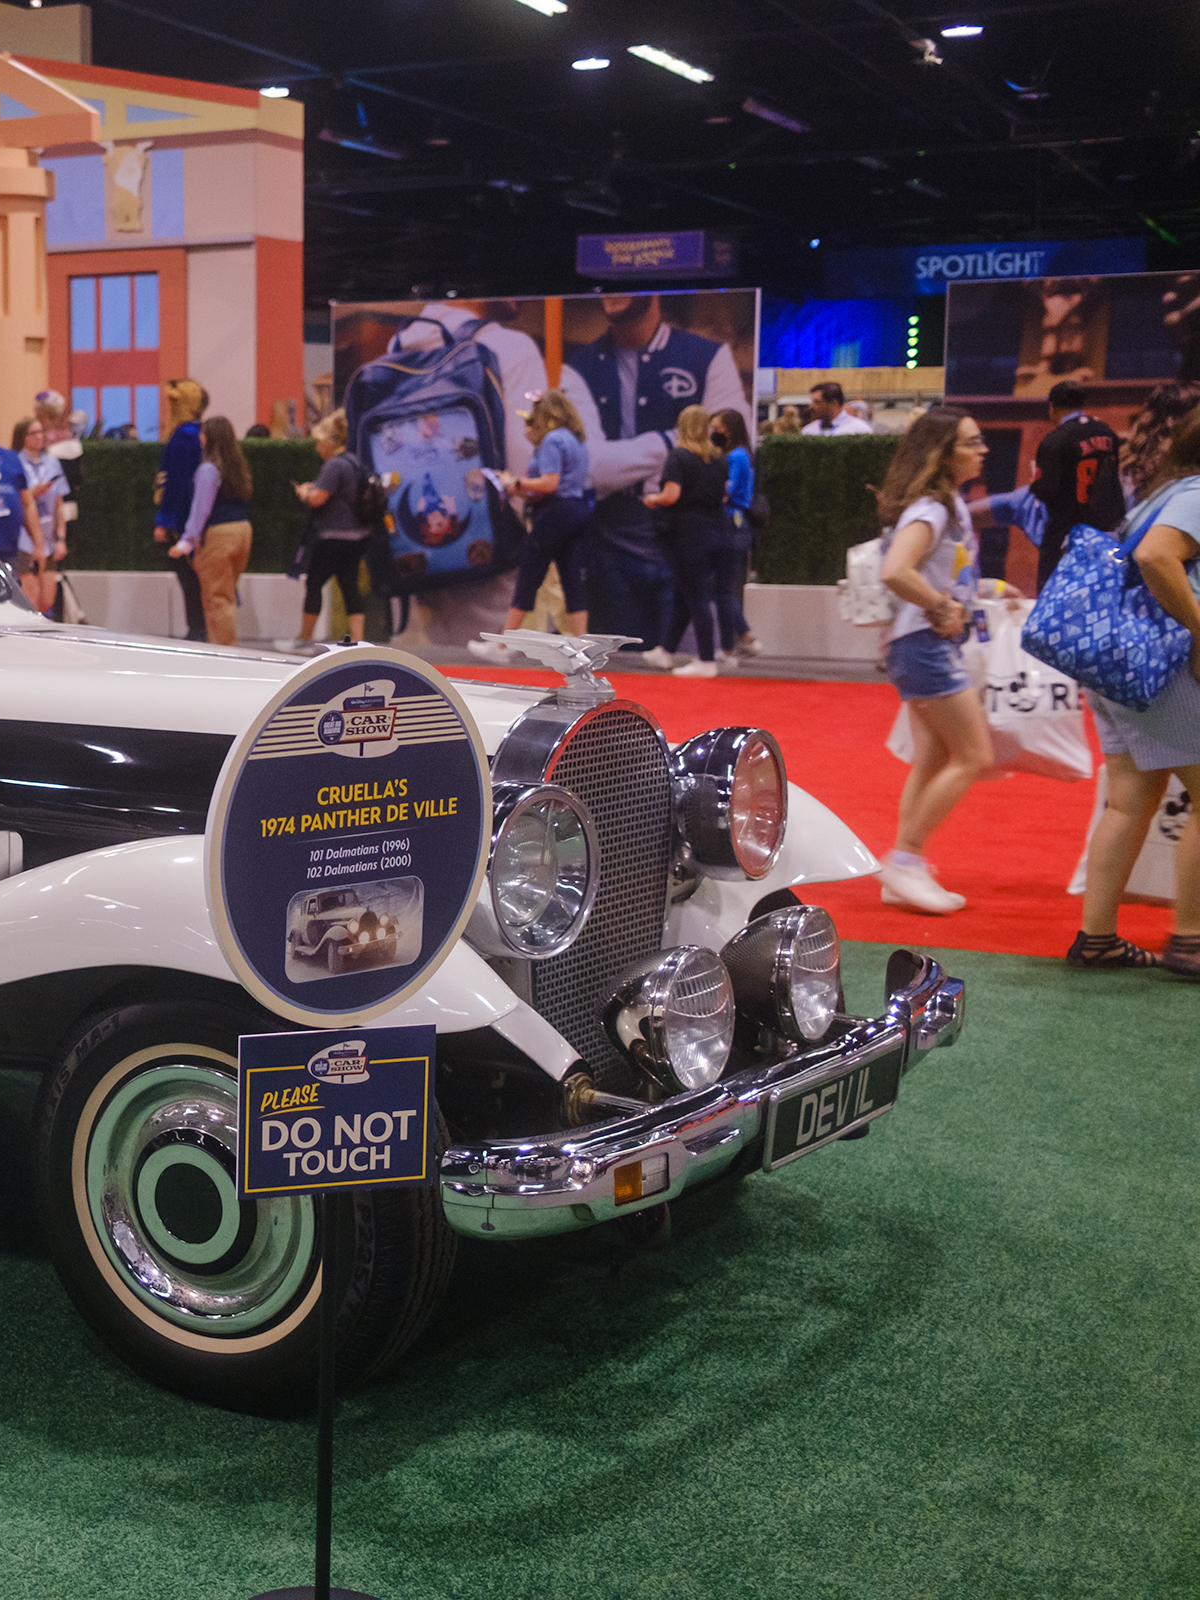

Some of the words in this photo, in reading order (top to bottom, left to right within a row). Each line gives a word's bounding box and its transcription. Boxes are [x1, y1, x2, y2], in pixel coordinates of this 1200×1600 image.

[915, 250, 1045, 279] SPOTLIGHT
[345, 724, 391, 736] SHOW
[350, 714, 387, 726] CAR
[317, 778, 408, 806] CRUELLA'S
[260, 816, 296, 838] 1974
[300, 806, 382, 833] PANTHER
[386, 802, 409, 823] DE
[413, 797, 458, 819] VILLE
[309, 850, 324, 862] 101
[325, 844, 379, 861] Dalmatians
[381, 838, 410, 855] (1996)
[307, 866, 322, 879] 102
[324, 860, 378, 877] Dalmatians
[380, 853, 412, 871] (2000)
[260, 1083, 321, 1112] PLEASE
[261, 1116, 322, 1152] DO
[334, 1109, 417, 1146] NOT
[283, 1145, 391, 1177] TOUCH
